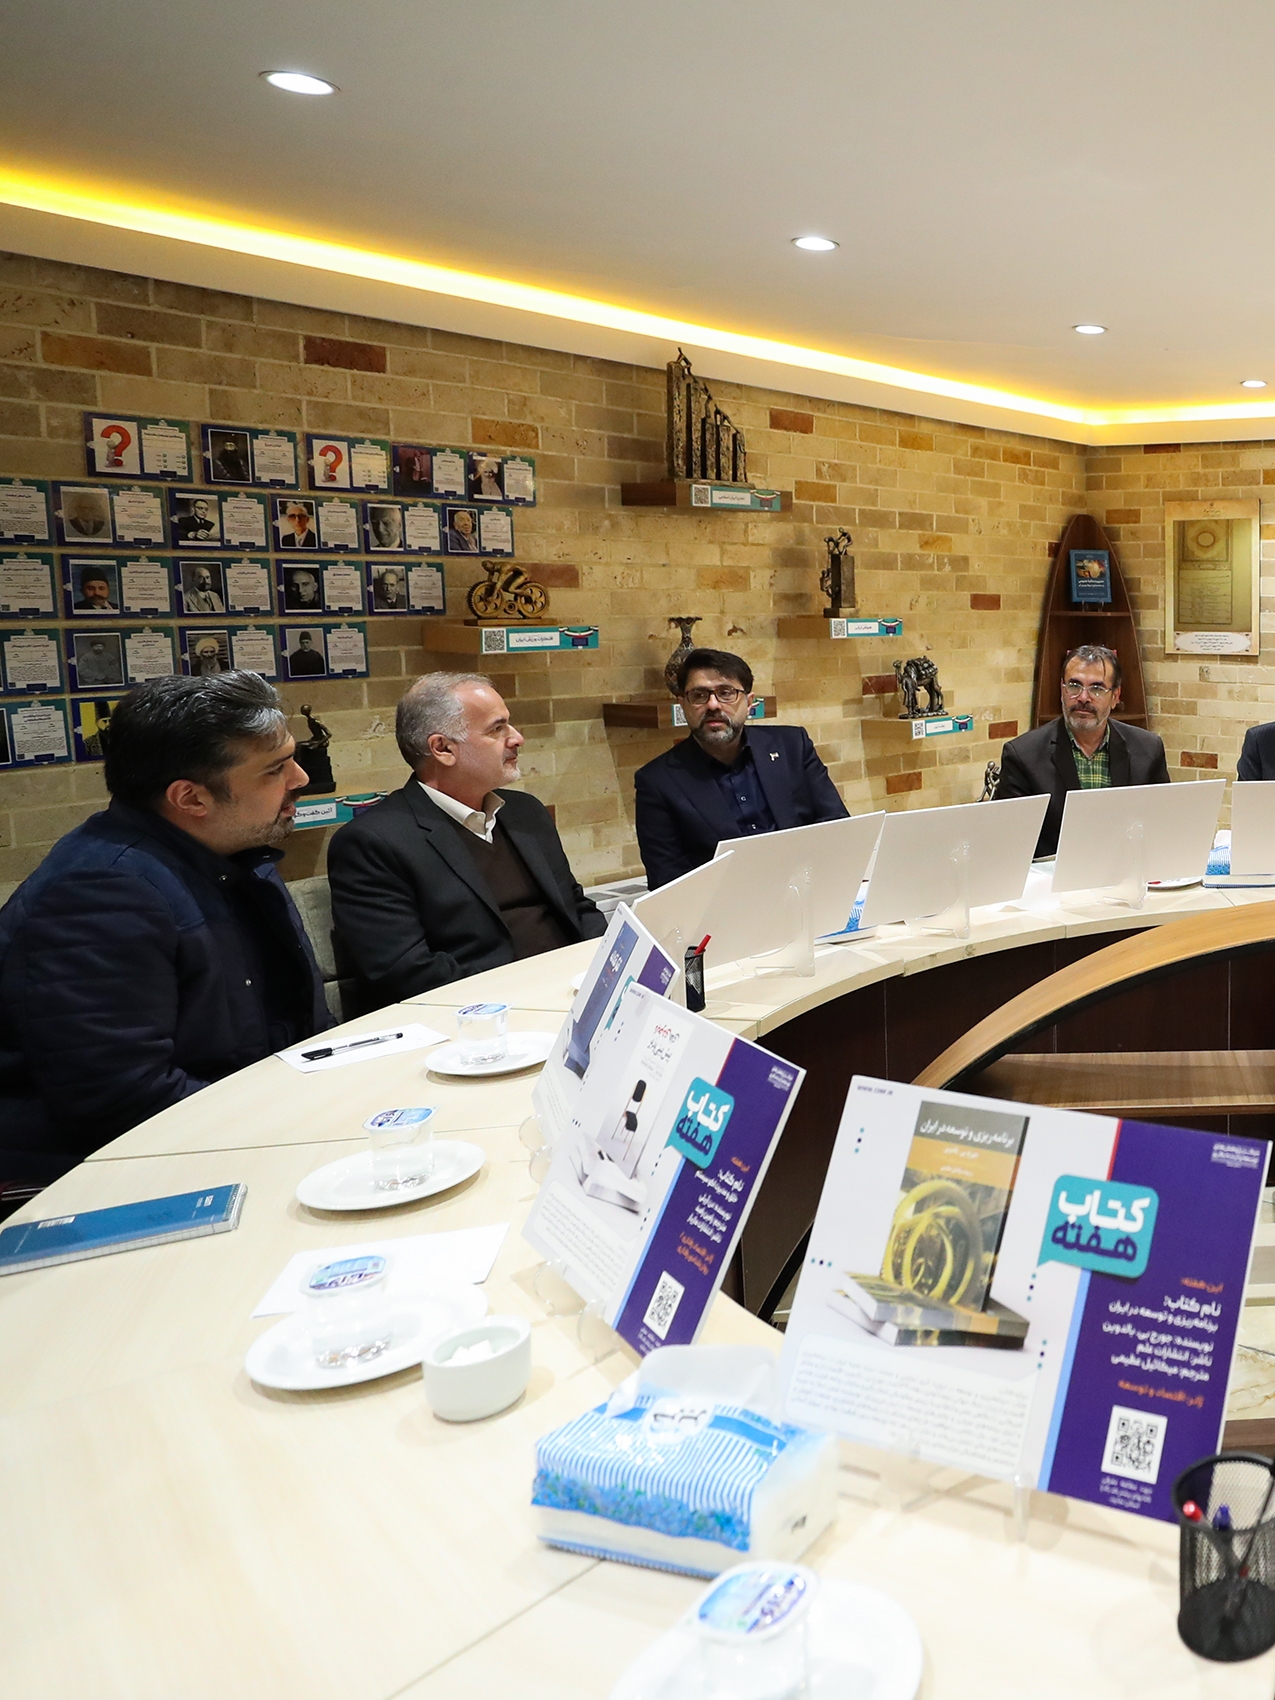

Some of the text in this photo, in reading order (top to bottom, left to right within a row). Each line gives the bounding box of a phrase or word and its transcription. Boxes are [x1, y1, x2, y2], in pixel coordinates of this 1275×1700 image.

[686, 1090, 731, 1132] کتاب
[920, 1118, 939, 1134] ایران
[936, 1124, 946, 1136] در
[944, 1124, 969, 1140] توسعه
[676, 1115, 713, 1157] هفته
[1057, 1189, 1151, 1233] کتاب
[1051, 1220, 1138, 1263] هفته
[1108, 1299, 1130, 1313] ایران
[1127, 1305, 1139, 1317] در
[1163, 1294, 1222, 1318] نام کتاب:
[1139, 1308, 1168, 1323] توسعه
[1136, 1341, 1154, 1355] علم
[1154, 1346, 1190, 1363] انتشارات
[1110, 1352, 1142, 1368] عظیمی
